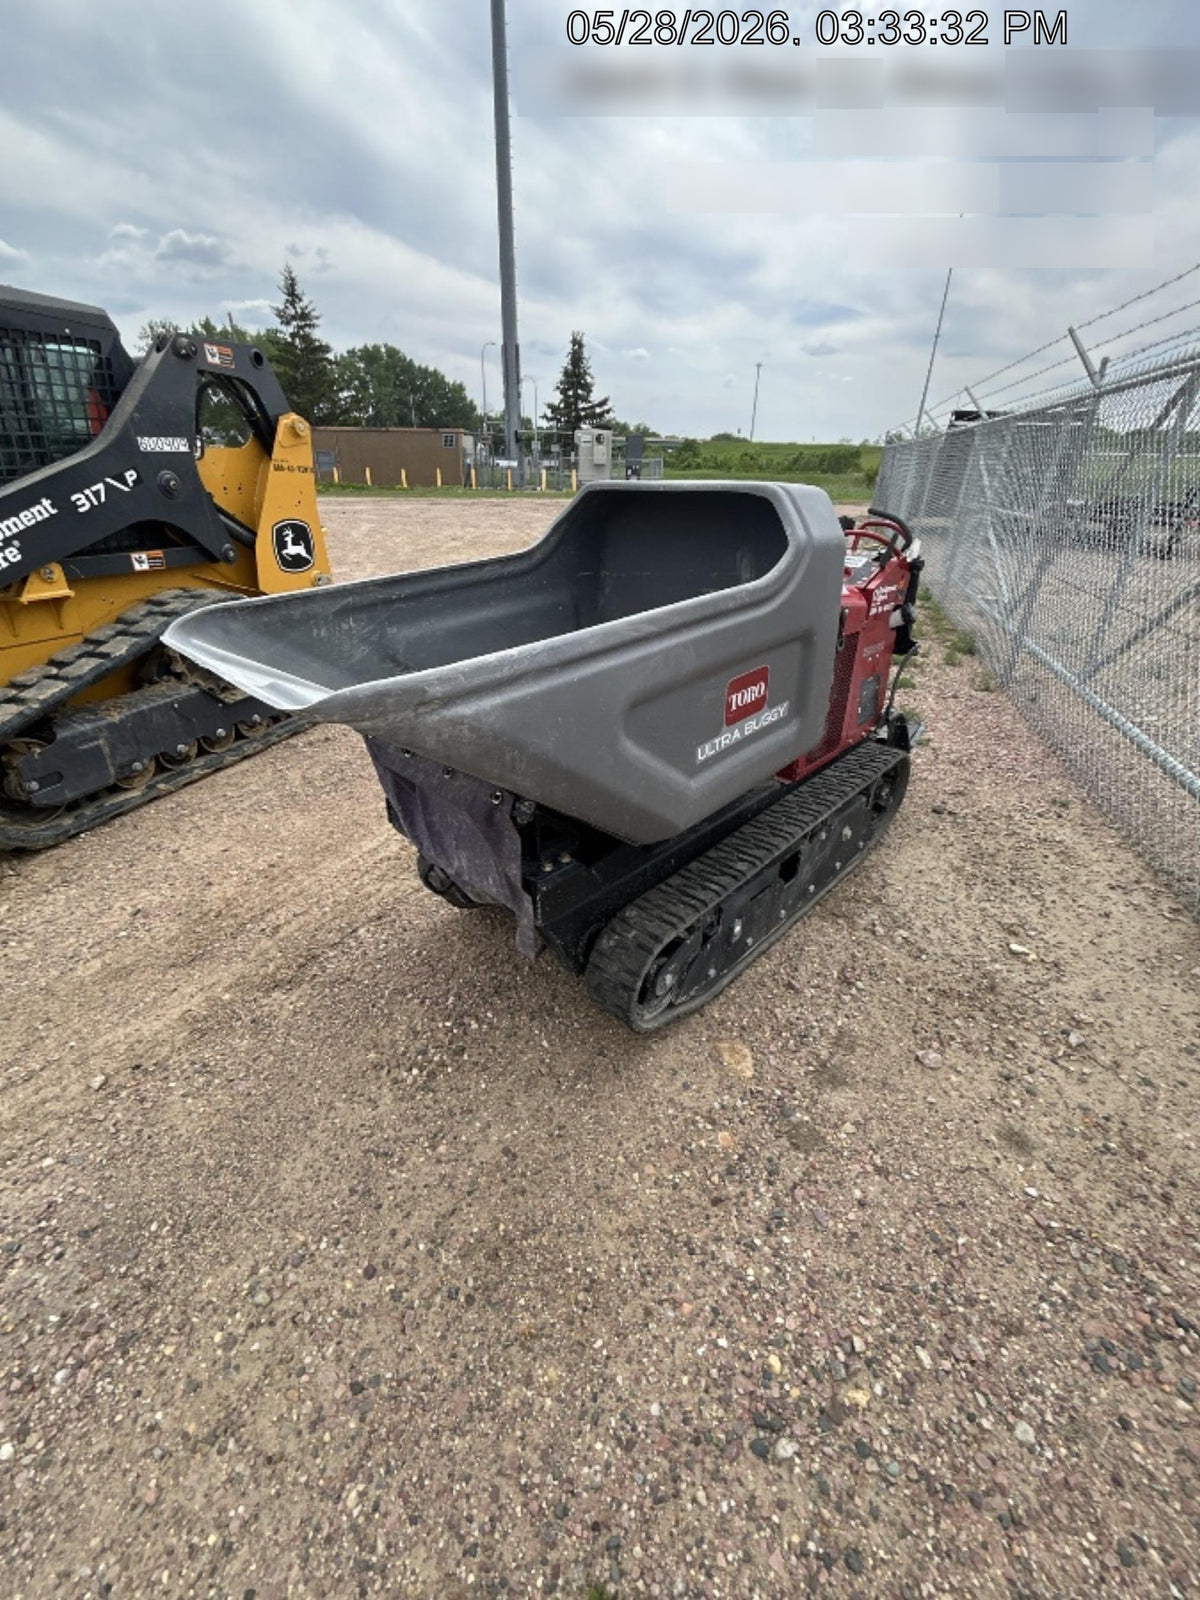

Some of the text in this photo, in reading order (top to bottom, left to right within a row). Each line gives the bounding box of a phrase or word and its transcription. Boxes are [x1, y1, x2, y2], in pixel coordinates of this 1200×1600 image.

[0, 497, 59, 541] ment
[729, 681, 765, 711] TORO
[697, 701, 789, 761] ULTRA BUGGY
